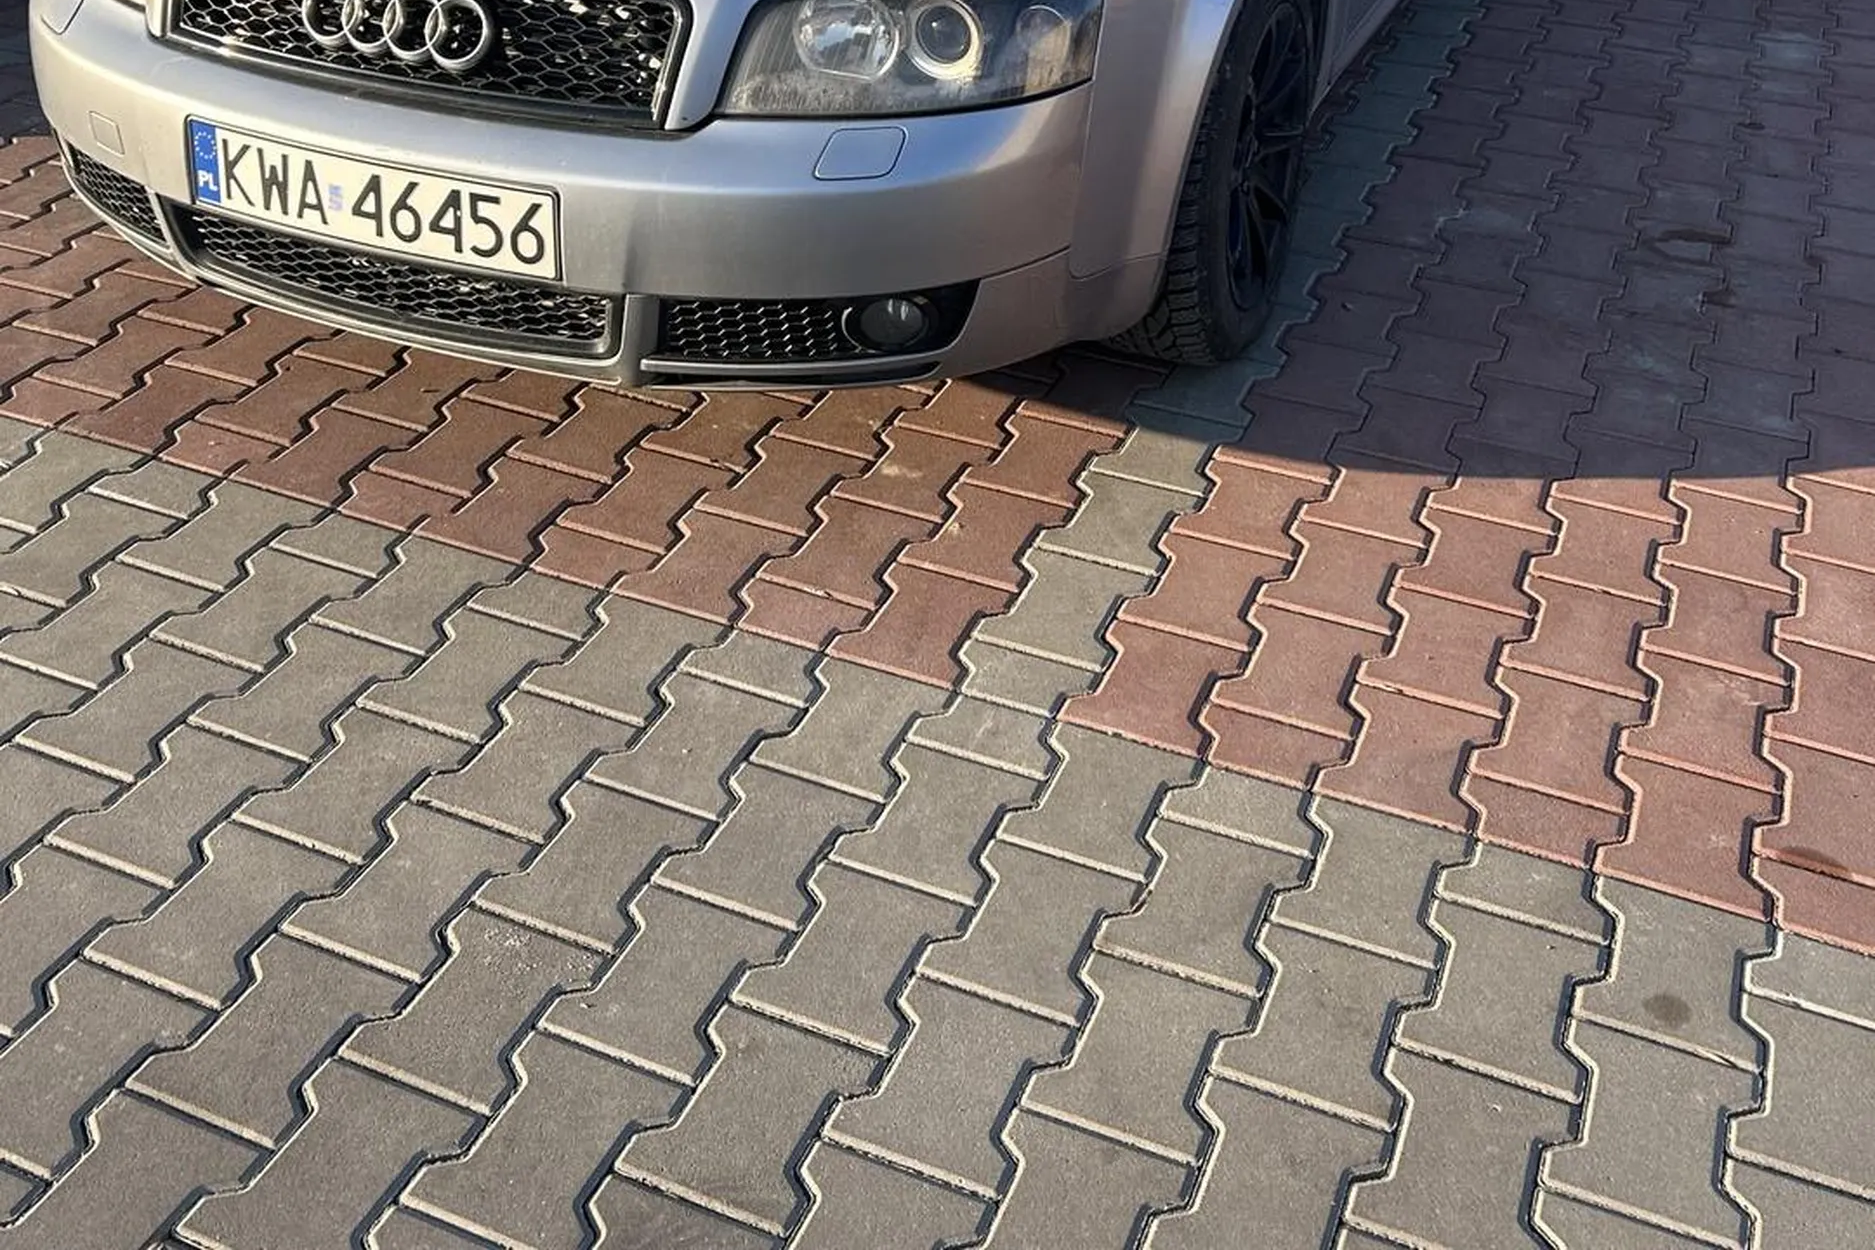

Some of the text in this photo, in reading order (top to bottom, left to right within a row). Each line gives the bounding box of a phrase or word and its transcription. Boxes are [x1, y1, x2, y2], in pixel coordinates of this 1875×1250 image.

[197, 170, 218, 191] PL
[222, 138, 545, 265] KWA 46456
